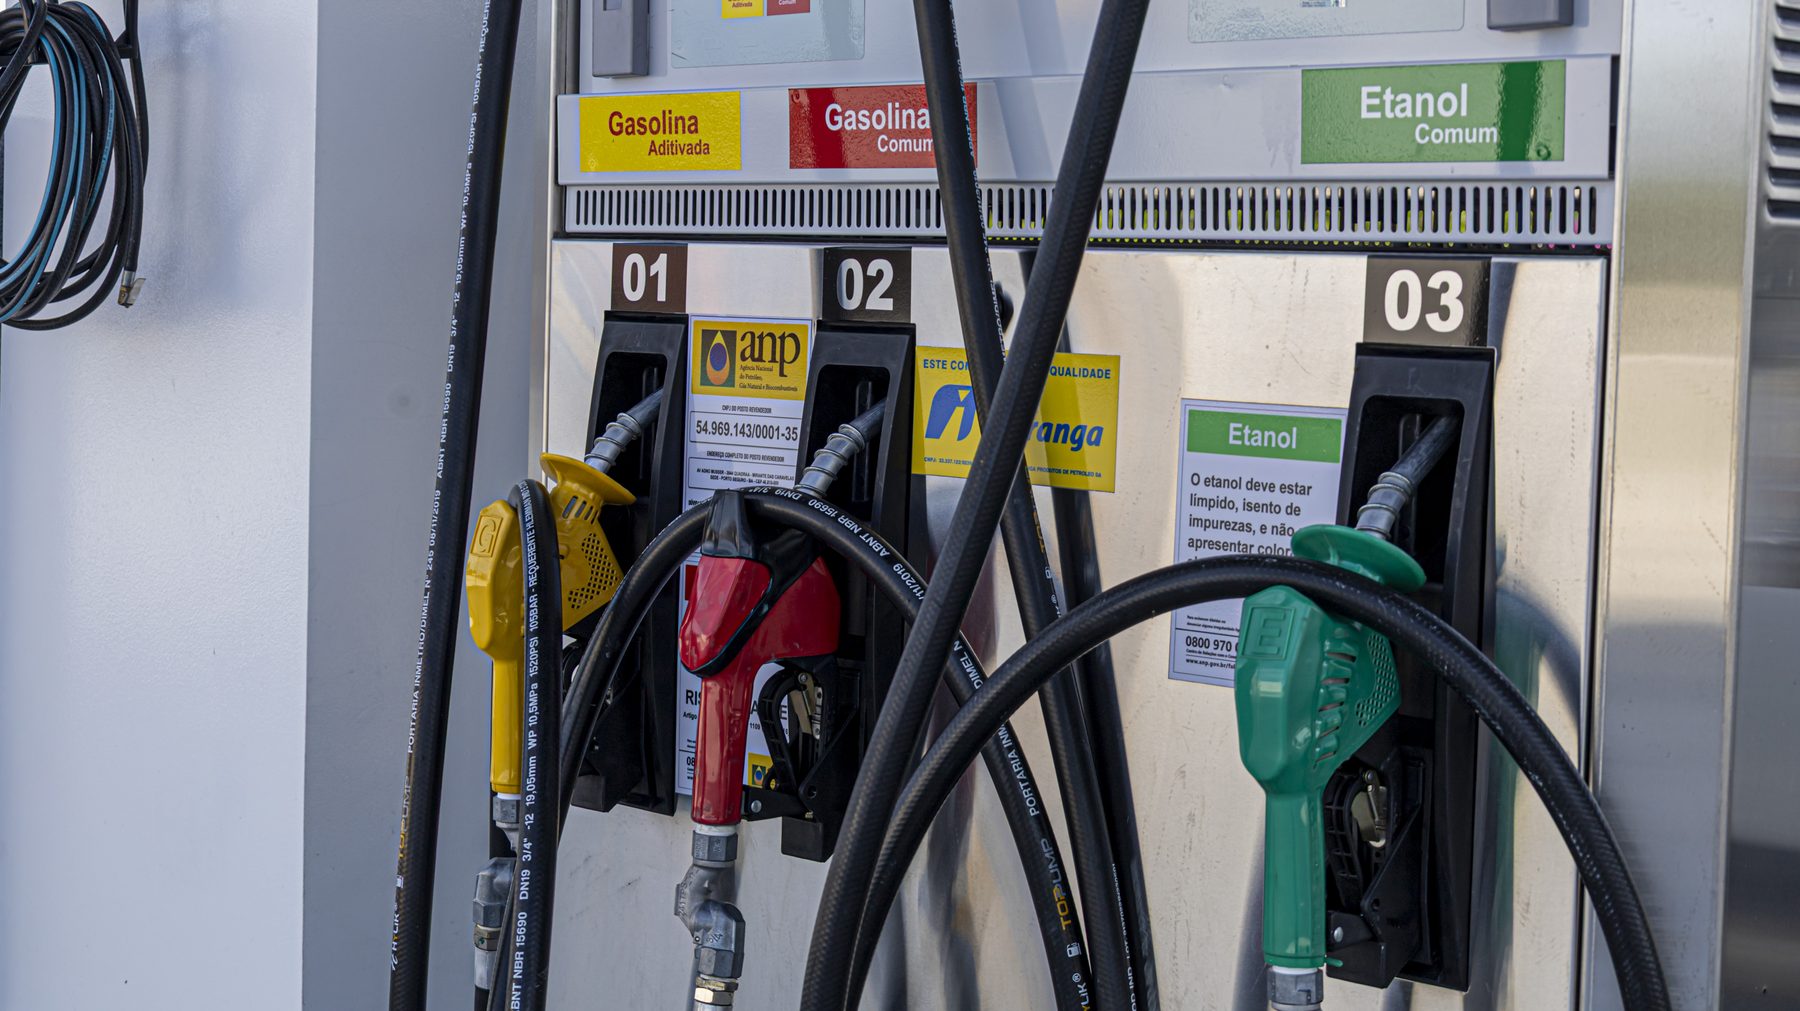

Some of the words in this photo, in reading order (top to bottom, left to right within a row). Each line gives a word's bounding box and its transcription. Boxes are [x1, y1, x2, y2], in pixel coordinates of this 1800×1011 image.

[1360, 83, 1468, 119] Etanol
[608, 108, 699, 137] Gasolina
[824, 102, 930, 132] Gasolina
[1414, 123, 1498, 145] Comum
[647, 138, 710, 156] Aditivada
[622, 252, 668, 302] 01
[836, 258, 894, 311] 02
[1384, 268, 1464, 333] 03
[740, 330, 801, 378] anp
[923, 358, 947, 370] ESTE
[1049, 366, 1111, 379] QUALIDADE
[696, 420, 798, 442] 54.969.143/0001-35
[1228, 422, 1298, 449] Etanol
[774, 488, 802, 500] DN19
[1190, 472, 1201, 486] O
[1203, 475, 1242, 490] etanol
[1245, 478, 1276, 493] deve
[1279, 482, 1312, 496] estar
[808, 498, 839, 518] 15690
[1189, 493, 1239, 513] límpido,
[1242, 498, 1282, 516] isento
[1285, 502, 1301, 517] de
[837, 509, 861, 534] NBR
[1188, 514, 1256, 536] impurezas,
[1259, 524, 1267, 535] e
[1271, 523, 1295, 537] não
[859, 533, 890, 558] ABNT
[1187, 537, 1254, 554] apresentar
[1257, 544, 1293, 557] color
[526, 529, 540, 588] REQUERENTE
[529, 594, 539, 633] 105BAR
[1185, 635, 1211, 649] 0800
[1213, 639, 1232, 652] 970
[529, 636, 539, 678] 1520PSI
[528, 682, 539, 725] 10,5MPa
[683, 711, 698, 721] Artigo
[527, 727, 538, 750] WP
[526, 755, 537, 807] 19,05mm
[1007, 748, 1040, 817] PORTARIA
[525, 812, 535, 830] -12
[522, 837, 533, 862] 3/4"
[519, 869, 531, 901] DN19
[515, 911, 528, 948] 15690
[512, 951, 525, 980] NBR
[1127, 966, 1135, 989] IND
